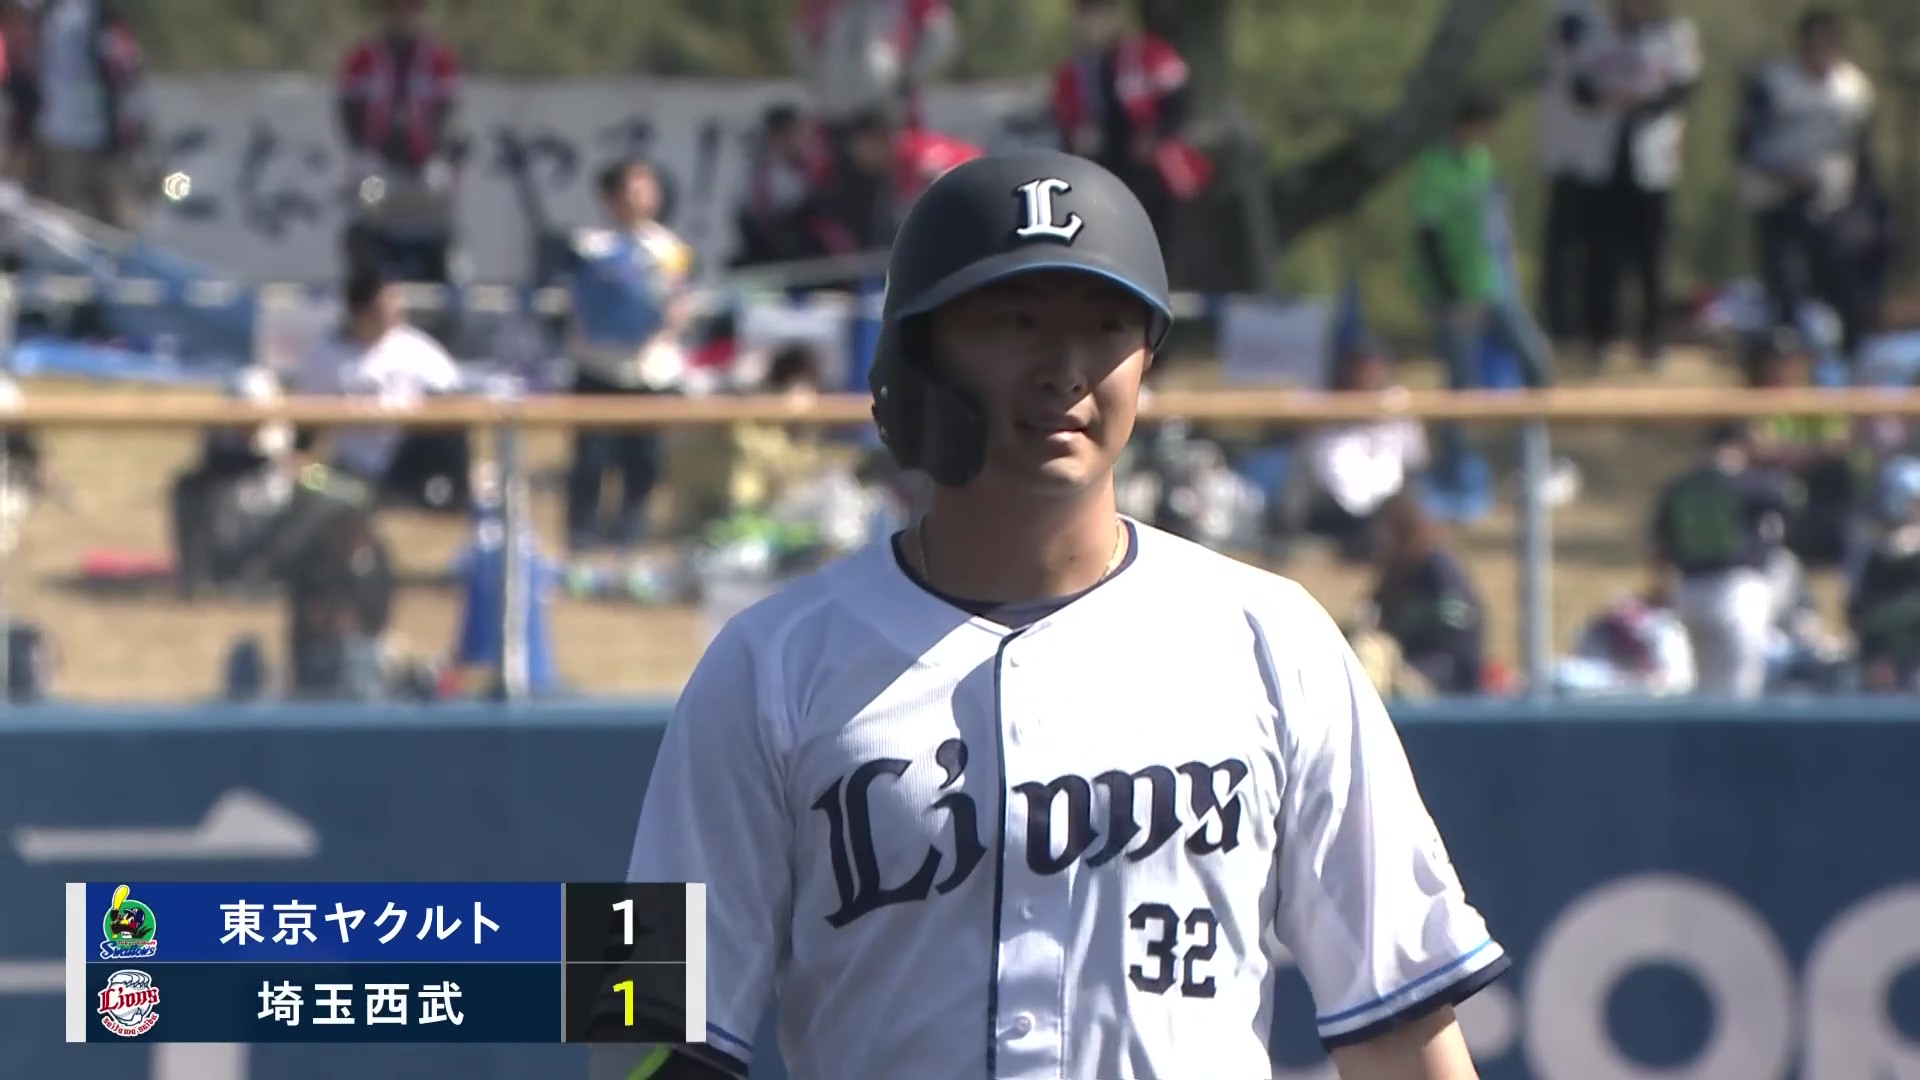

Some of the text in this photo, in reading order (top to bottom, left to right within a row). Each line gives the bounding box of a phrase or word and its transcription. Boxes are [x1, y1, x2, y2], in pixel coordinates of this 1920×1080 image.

[1015, 177, 1084, 244] L
[810, 737, 1249, 929] Lions
[1128, 902, 1218, 998] 32
